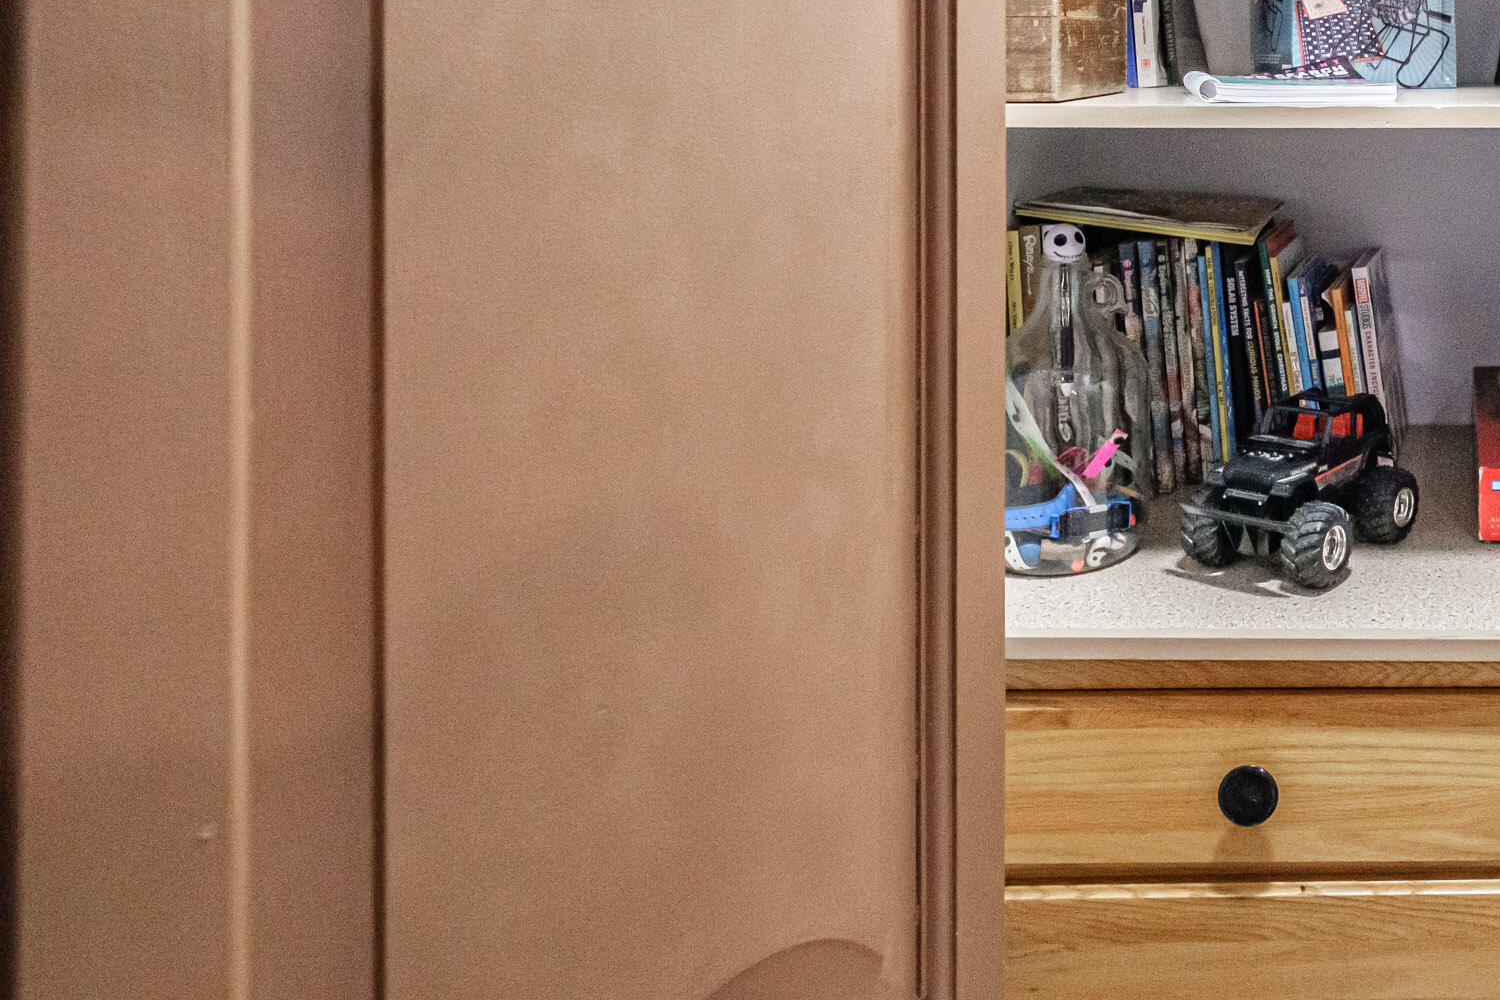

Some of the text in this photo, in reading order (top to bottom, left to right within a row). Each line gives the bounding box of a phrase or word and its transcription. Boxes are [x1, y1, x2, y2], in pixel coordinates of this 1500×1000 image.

[1238, 270, 1248, 307] INTERESTING
[1355, 279, 1369, 304] MARVEL
[1226, 277, 1239, 336] SOLAR SYSTEM
[1241, 307, 1250, 327] FACTS
[1359, 304, 1371, 329] STUDIOS
[1264, 268, 1288, 392] HOW THE GRINCH STOLE CHRISTMAS
[1247, 341, 1258, 374] CURIOUS
[1364, 331, 1376, 369] CHARACTER
[1252, 375, 1261, 401] MINDS
